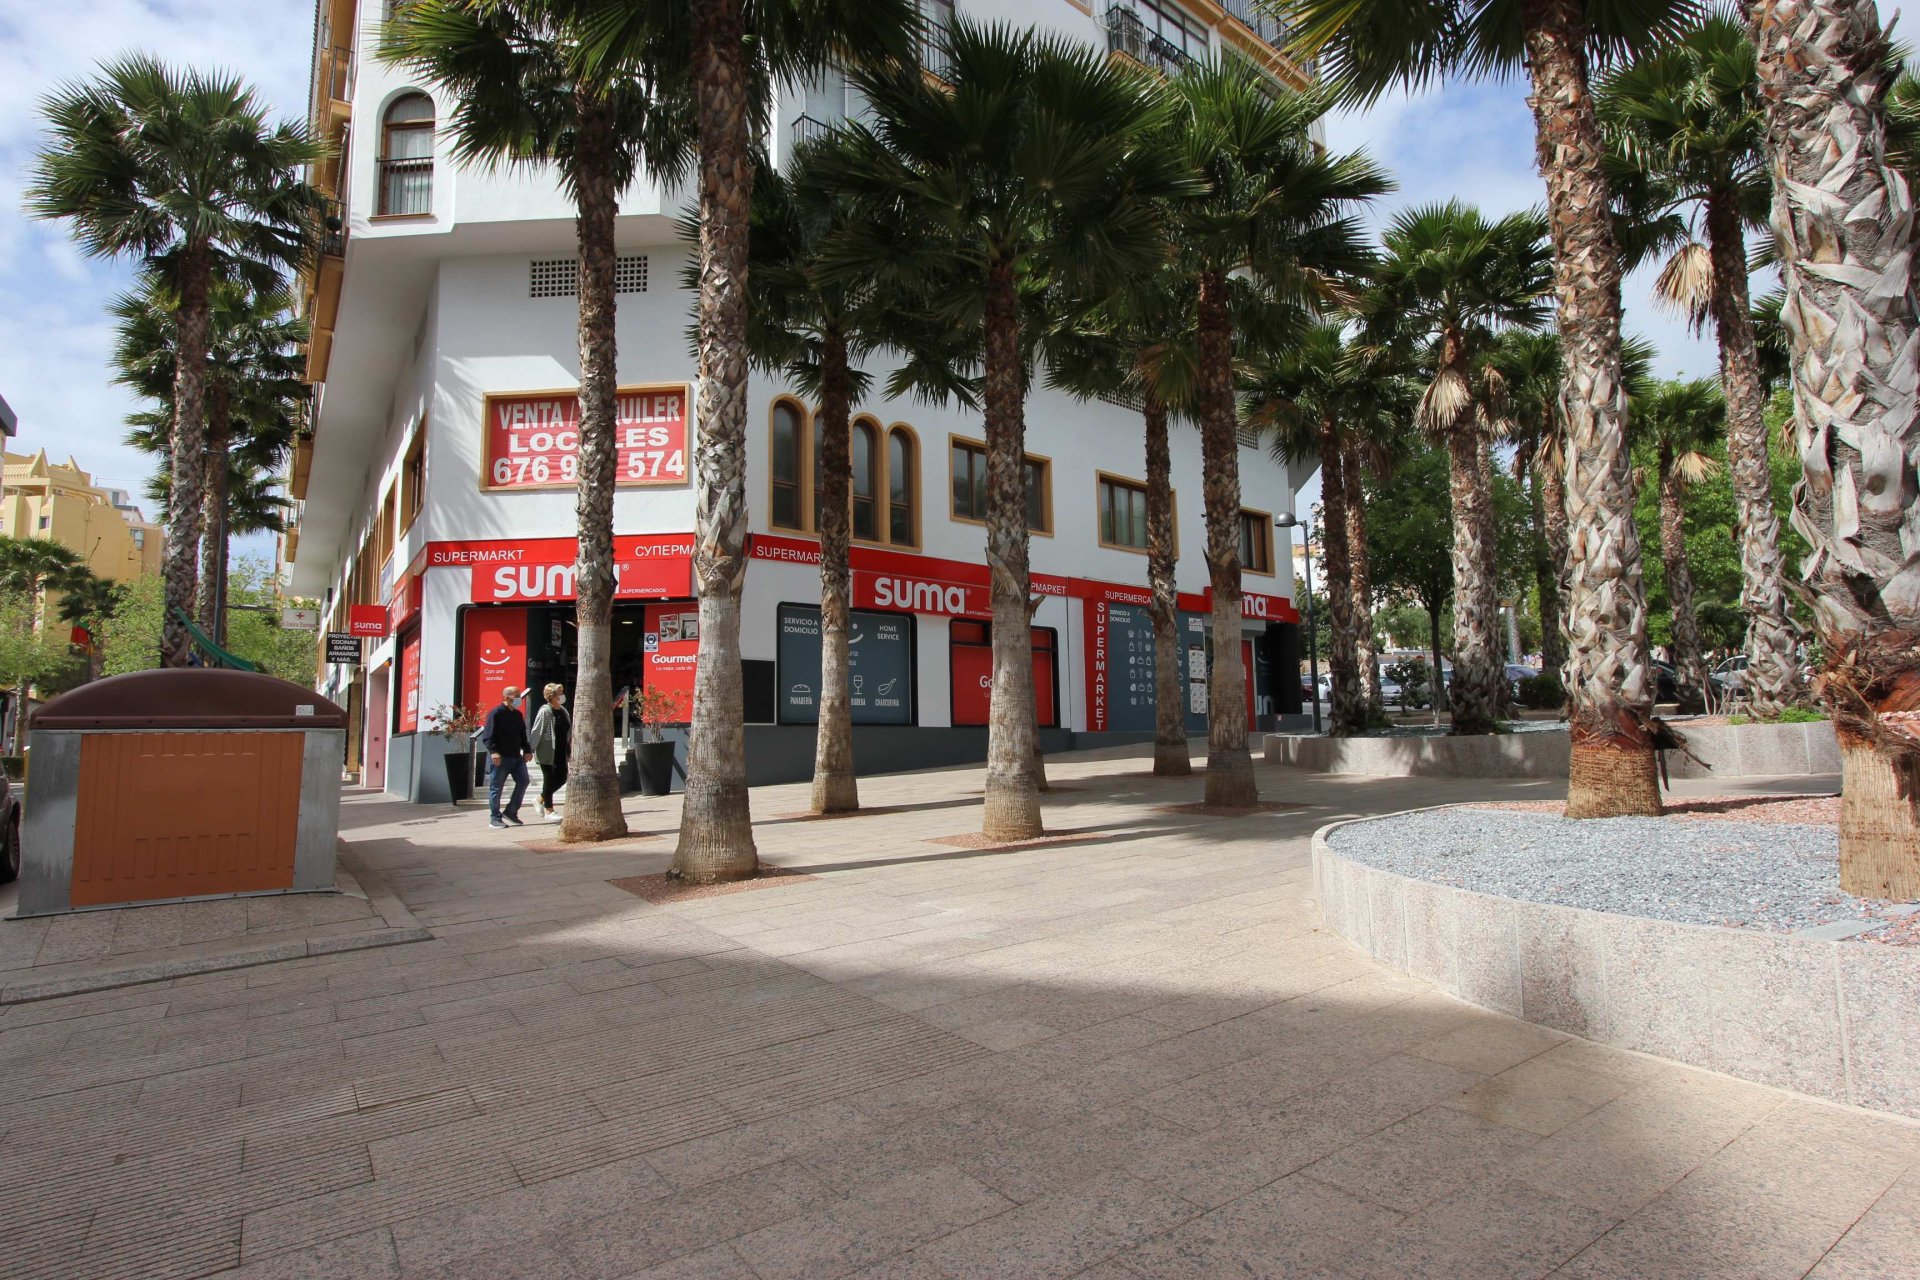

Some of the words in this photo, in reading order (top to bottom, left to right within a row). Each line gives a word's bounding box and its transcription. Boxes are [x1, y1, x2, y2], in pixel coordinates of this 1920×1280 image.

[499, 401, 563, 429] VENTA
[509, 427, 669, 452] LOCES
[493, 456, 550, 484] 676
[627, 450, 685, 478] 574
[433, 549, 525, 562] SUPERMARKT
[756, 545, 821, 563] SUPERMAR
[493, 564, 620, 598] sum
[874, 577, 965, 614] suma
[1105, 590, 1152, 604] SUPERMERCA
[354, 621, 382, 630] suma
[784, 617, 813, 625] SERVICIO
[784, 626, 819, 635] DOMICILIO
[877, 633, 900, 641] SERVICE
[652, 653, 697, 664] Gourmet
[1095, 602, 1105, 730] SUPERMARKET
